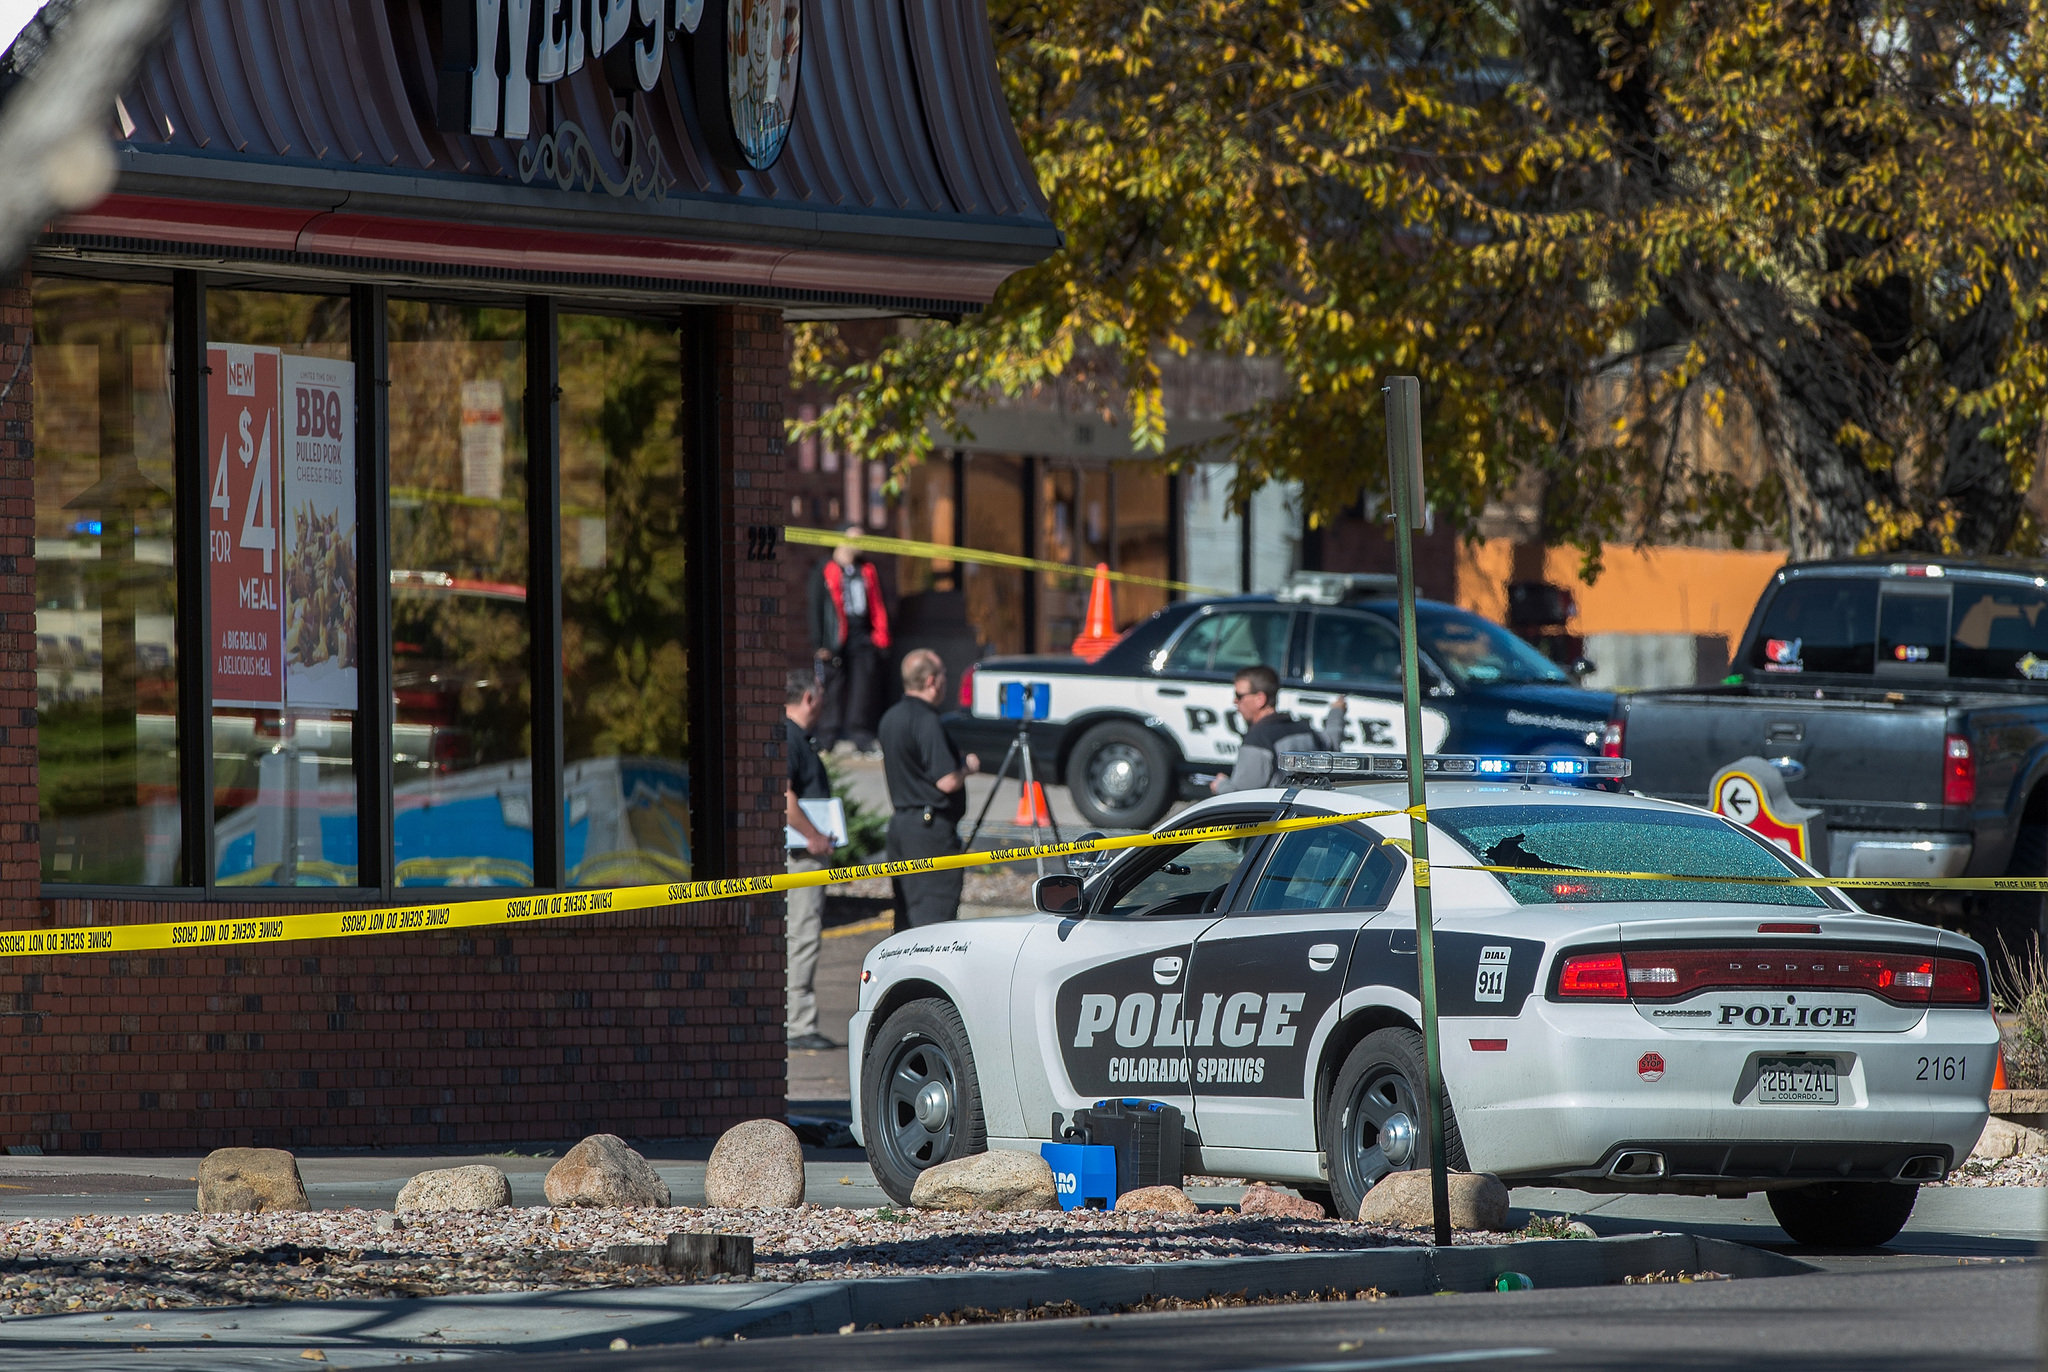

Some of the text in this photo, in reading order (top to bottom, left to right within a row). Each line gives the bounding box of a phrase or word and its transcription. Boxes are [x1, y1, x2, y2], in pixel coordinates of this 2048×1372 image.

[229, 363, 253, 387] NEW
[296, 387, 343, 442] BBQ
[296, 441, 342, 465] PULLED PORK
[210, 432, 230, 521] 4
[296, 466, 342, 485] CHEESE FRIES
[210, 530, 231, 563] FOR
[748, 526, 776, 560] 222
[239, 577, 277, 610] MEAL
[222, 630, 267, 651] A BIG DEAL ON
[218, 655, 272, 676] A DELICIOUS MEAL
[856, 866, 870, 878] NOT
[872, 864, 883, 876] DO
[886, 861, 909, 874] SCENE
[911, 858, 934, 871] CRIME
[668, 875, 773, 900] CRIME SCENE DO NOT CROSS
[1993, 880, 2017, 888] POLICE
[2018, 880, 2036, 888] LINE
[506, 892, 613, 918] CRIME SCENE DO NOT CROSS
[172, 920, 284, 944] CRIME SCENE DO NOT CROSS
[341, 908, 450, 933] CRIME SCENE DO NOT CROSS
[28, 935, 44, 952] NOT
[46, 934, 57, 950] DO
[61, 932, 85, 950] SCENE
[88, 930, 112, 948] CRIME
[1484, 951, 1506, 960] DIAL
[1729, 963, 1850, 972] DODGE
[1478, 971, 1503, 995] 911
[1073, 991, 1306, 1048] POLICE
[1718, 1005, 1857, 1027] POLICE
[1108, 1056, 1265, 1084] COLORADO SPRINGS
[1915, 1056, 1968, 1082] 2161
